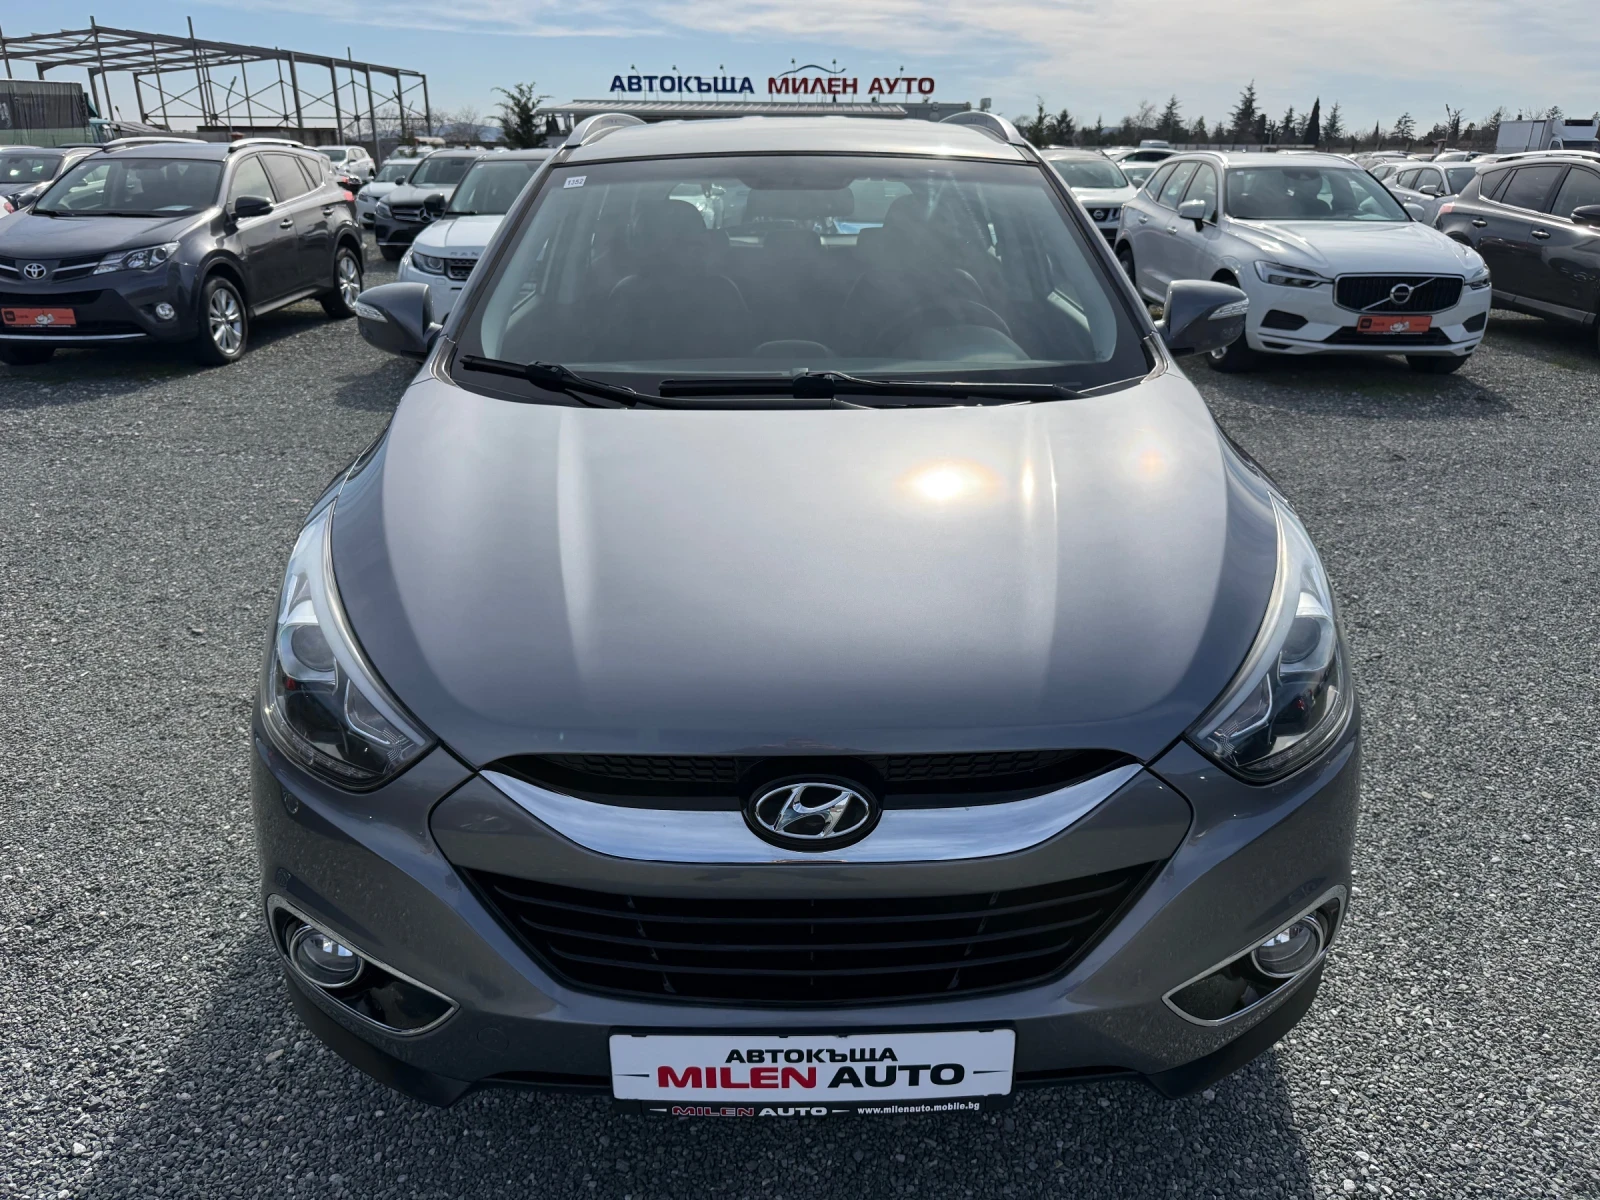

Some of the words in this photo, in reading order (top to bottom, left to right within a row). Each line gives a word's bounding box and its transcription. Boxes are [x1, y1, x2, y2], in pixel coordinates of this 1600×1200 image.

[768, 77, 858, 94] МИЛЕН
[868, 77, 935, 94] АУТО
[657, 1066, 817, 1088] MILEN
[827, 1063, 965, 1088] AUTO
[672, 1106, 754, 1117] MILEN
[758, 1107, 828, 1117] AUTO
[857, 1102, 980, 1115] www.milenauto.mobile.bg
